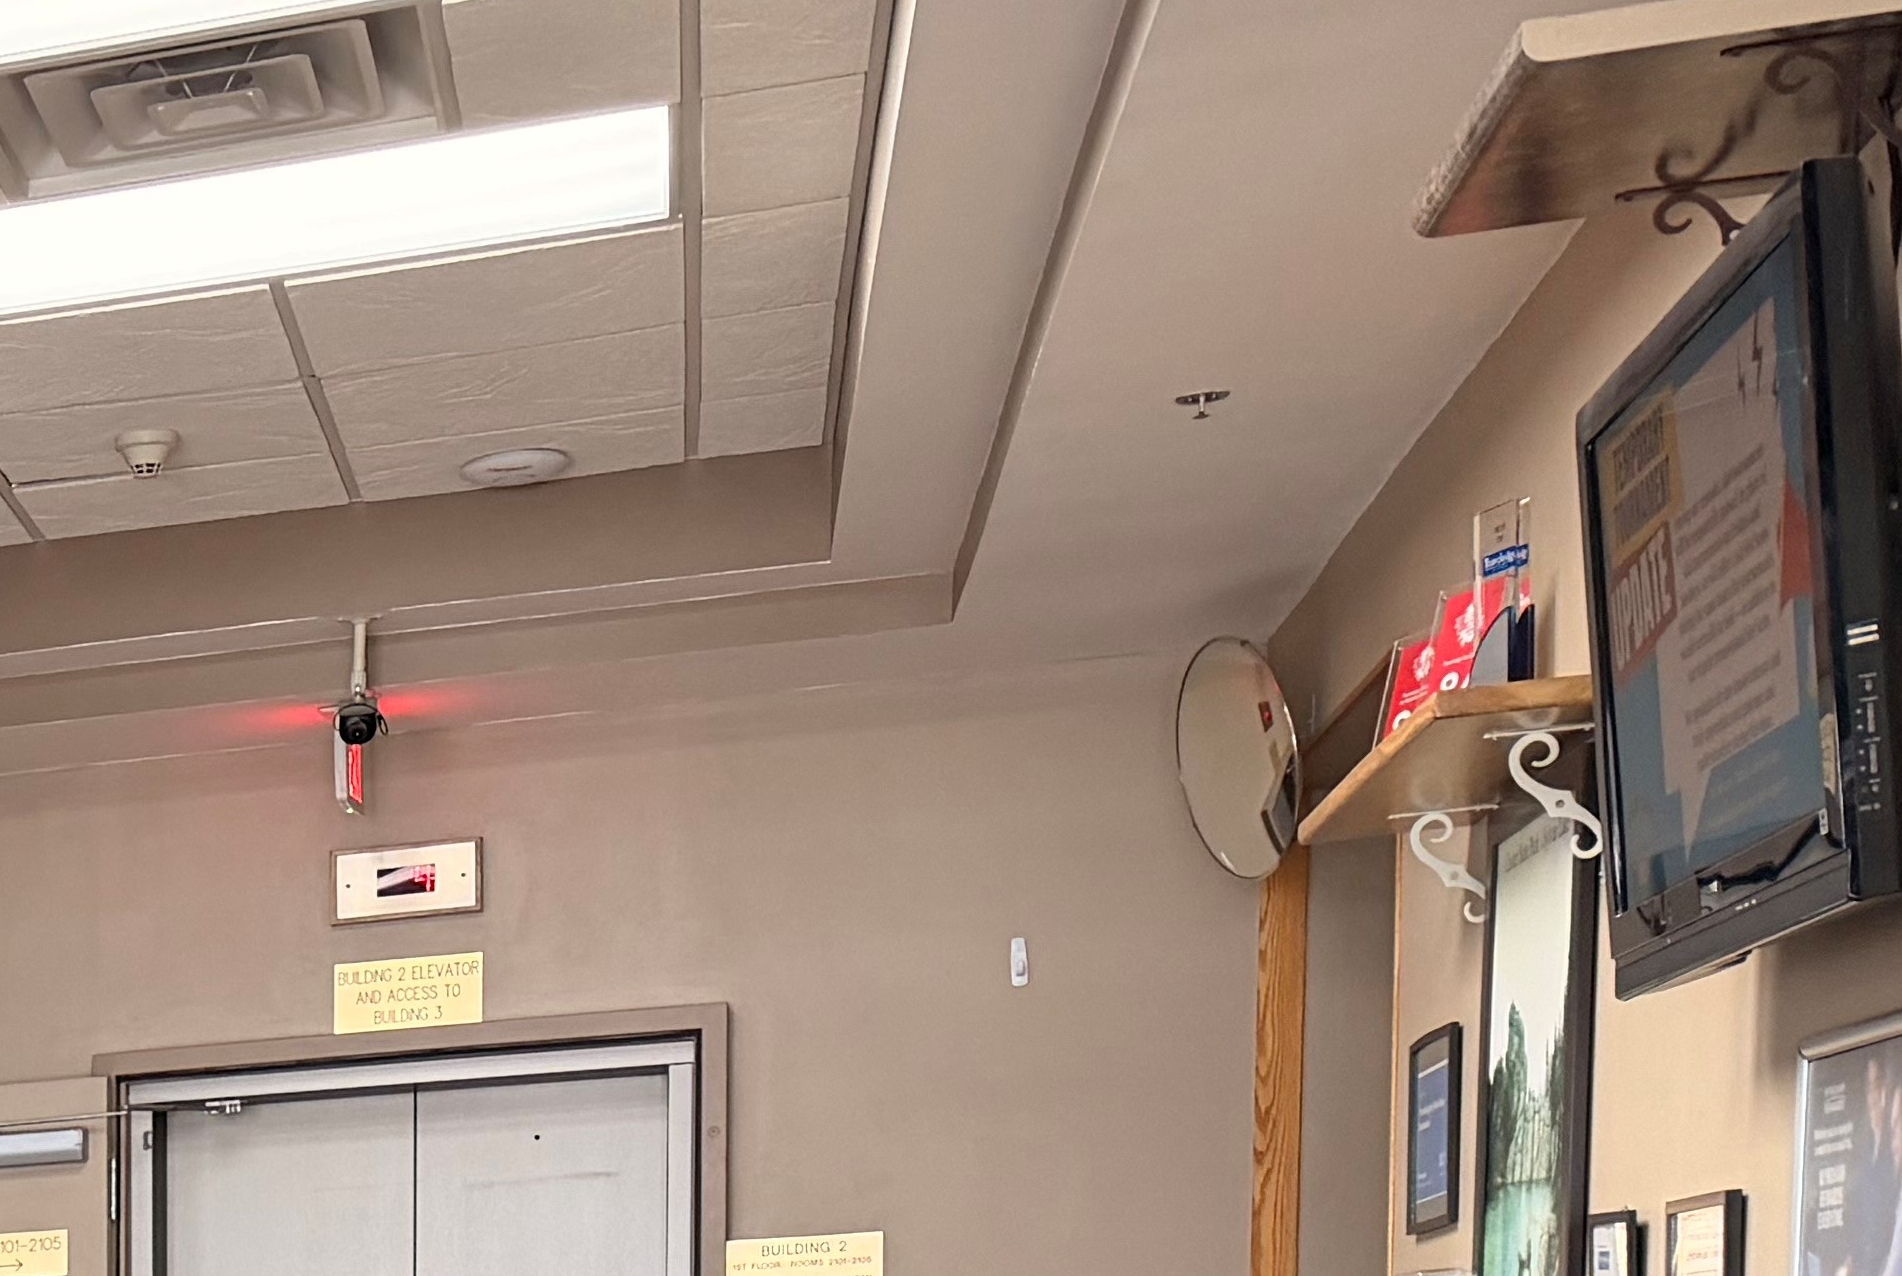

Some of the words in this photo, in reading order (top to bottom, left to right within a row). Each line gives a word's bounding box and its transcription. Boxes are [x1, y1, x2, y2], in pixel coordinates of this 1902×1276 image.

[338, 968, 392, 986] BUILDING
[398, 967, 405, 981] 2
[412, 960, 479, 980] ELEVATOR
[356, 990, 381, 1005] AND
[387, 985, 438, 1002] ACCESS
[445, 983, 461, 997] TO
[374, 1007, 428, 1024] BUILDING
[435, 1006, 443, 1019] 3
[761, 1241, 831, 1257] BUILDING
[839, 1240, 847, 1252] 2
